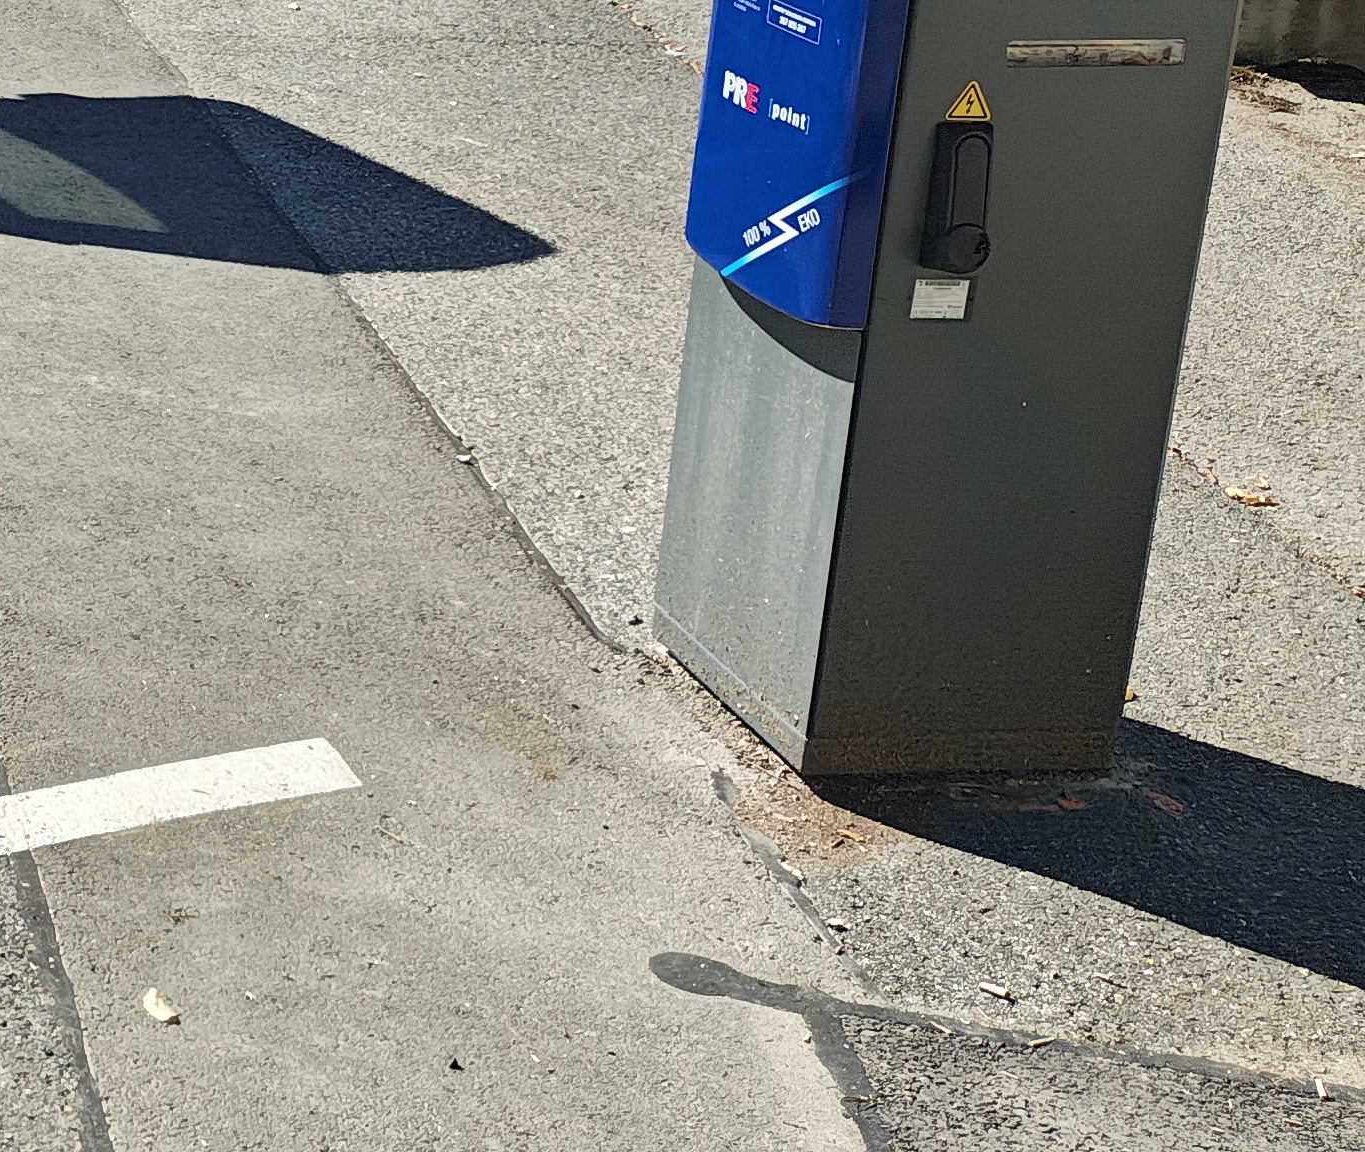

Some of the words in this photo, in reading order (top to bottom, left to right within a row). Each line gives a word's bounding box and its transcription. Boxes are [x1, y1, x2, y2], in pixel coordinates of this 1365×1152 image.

[722, 69, 760, 115] PRE
[742, 225, 761, 248] 100
[758, 219, 772, 238] %
[797, 207, 821, 233] EKO
